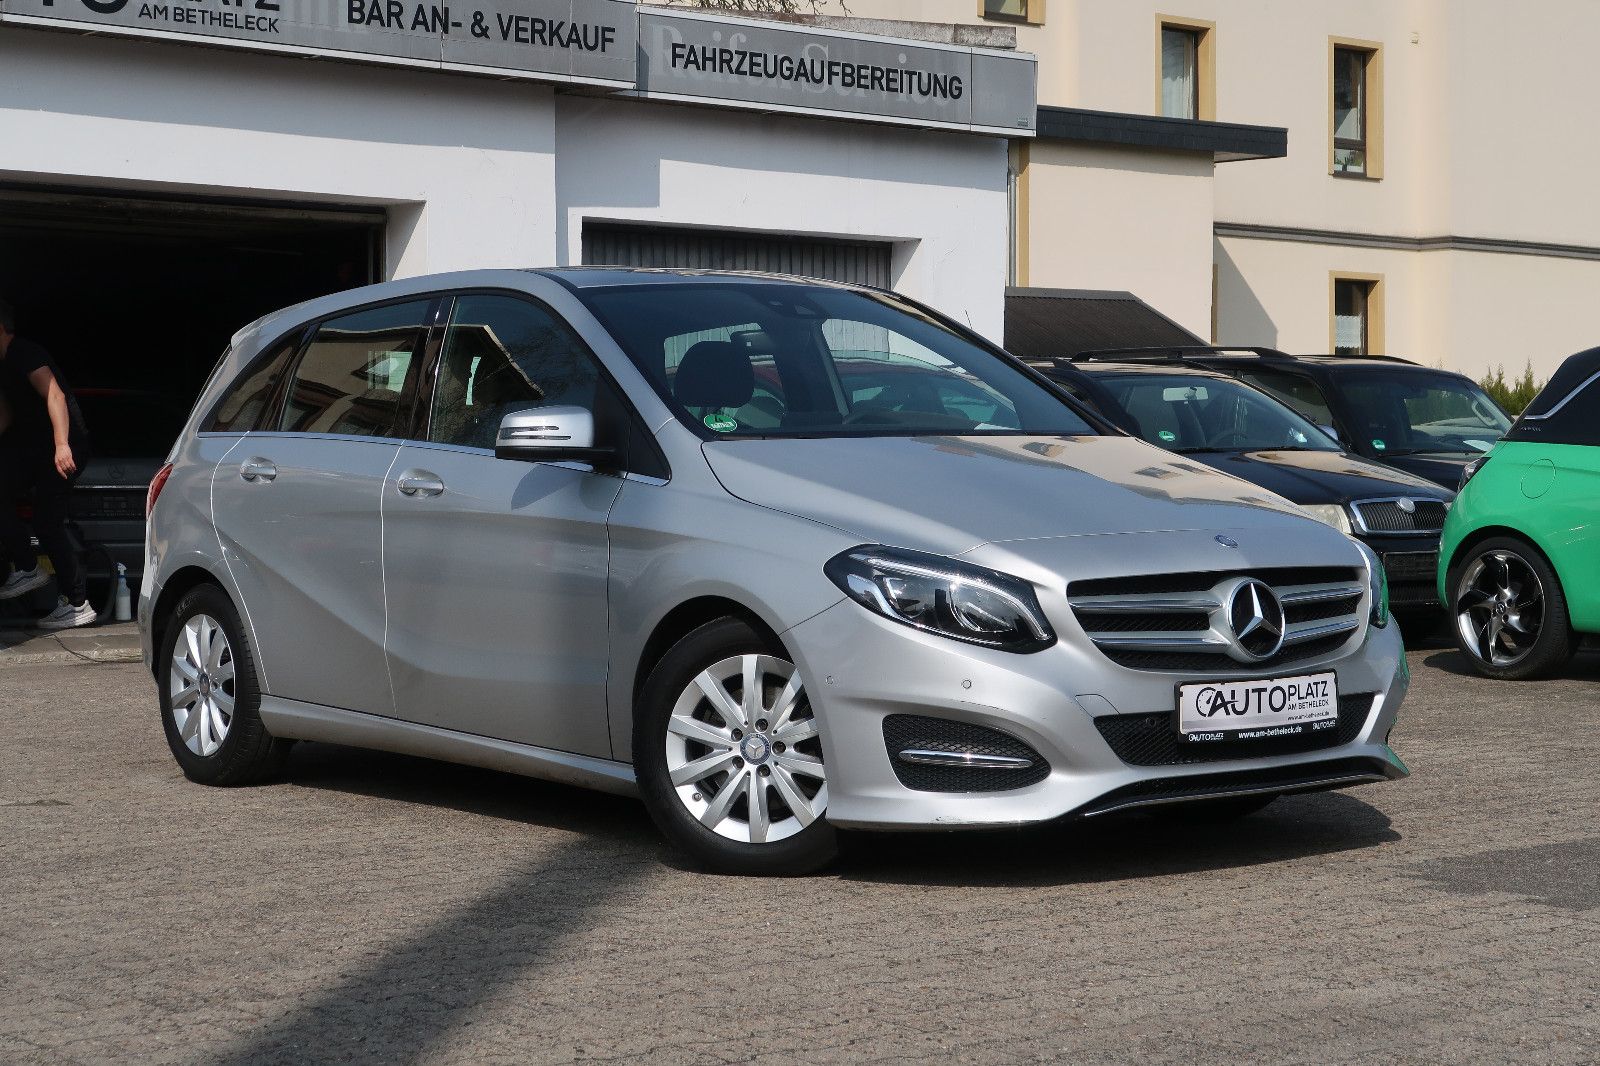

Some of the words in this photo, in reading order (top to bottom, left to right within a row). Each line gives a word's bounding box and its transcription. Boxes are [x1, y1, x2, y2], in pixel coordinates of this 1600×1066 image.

[138, 3, 168, 21] AM
[173, 6, 280, 34] BETHELECK
[347, 0, 404, 30] BAR
[470, 10, 491, 40] &
[497, 13, 616, 53] VERKAUF
[671, 42, 963, 100] FAHRZEUGAUFBEREITUNG
[1287, 703, 1297, 711] AM
[1298, 699, 1329, 710] BETHELECK
